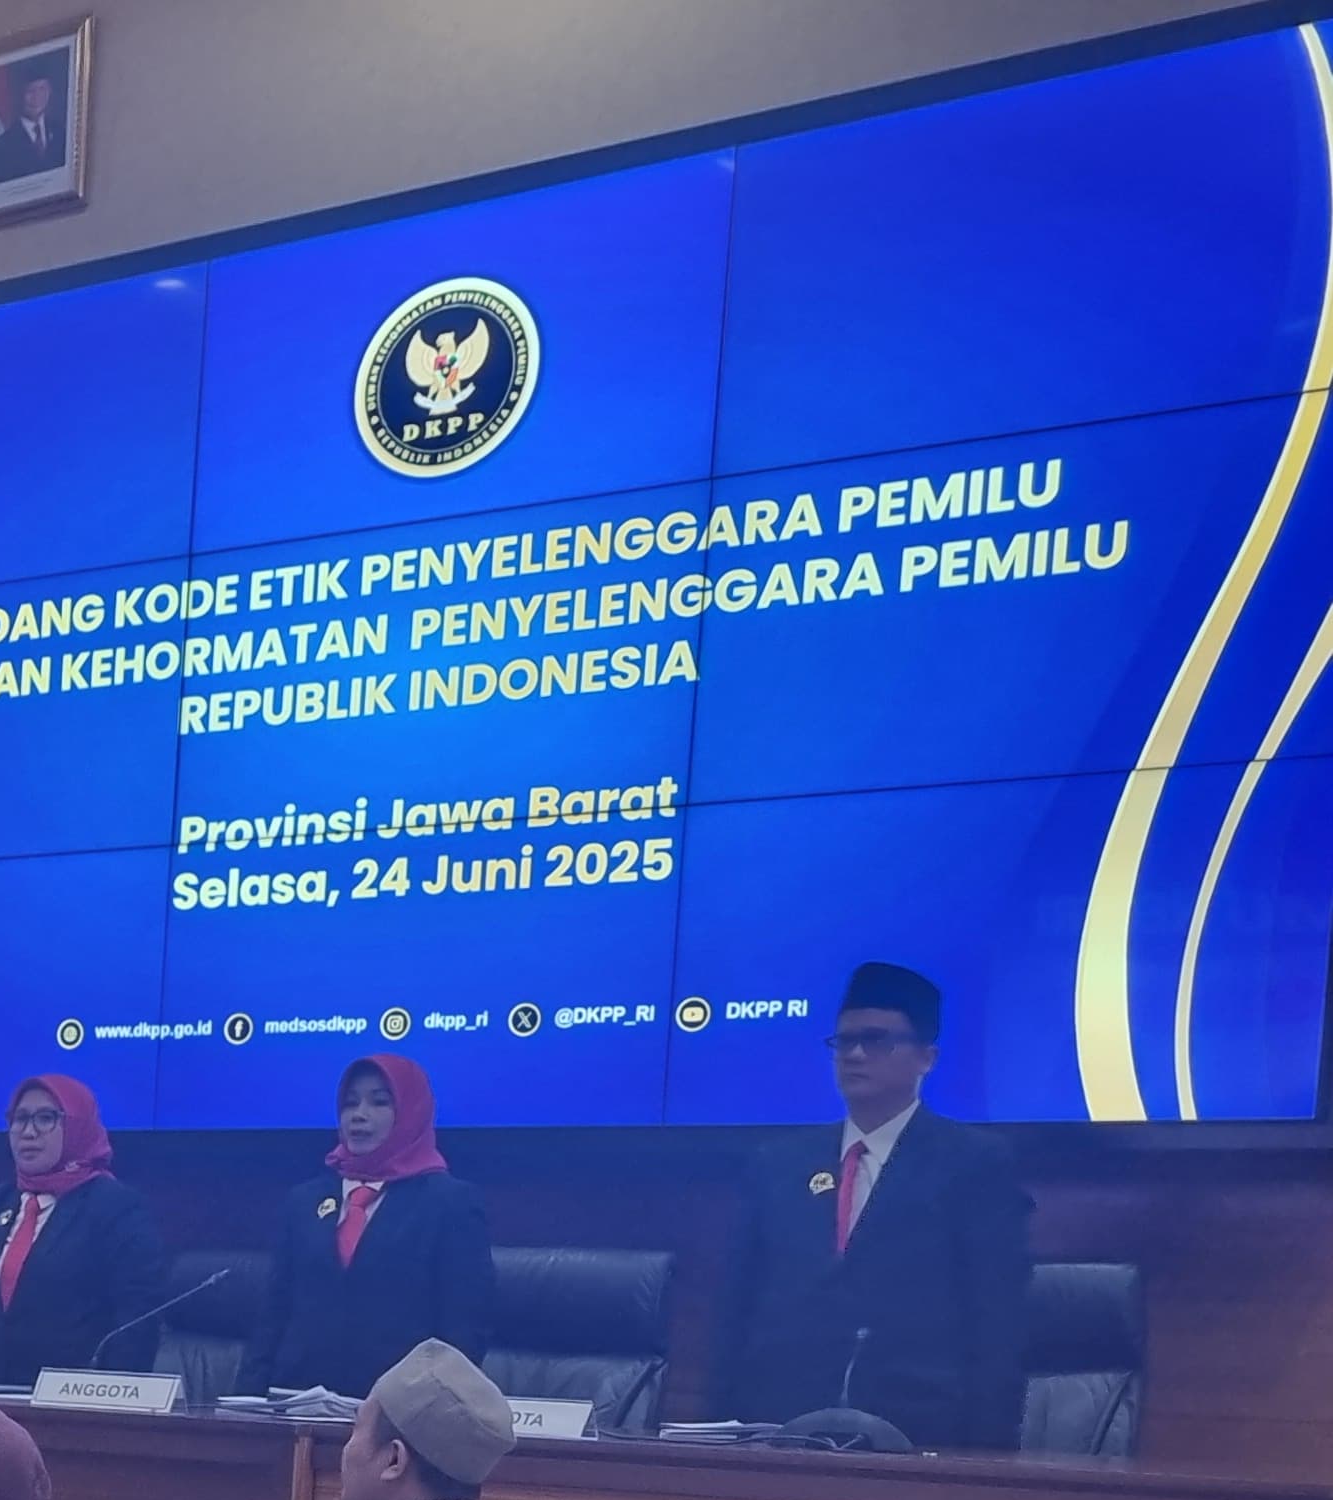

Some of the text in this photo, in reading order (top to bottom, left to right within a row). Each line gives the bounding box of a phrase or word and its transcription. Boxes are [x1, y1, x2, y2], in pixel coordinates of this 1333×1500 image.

[402, 413, 485, 442] DKPP
[114, 574, 239, 629] KODE
[249, 559, 350, 610] ETIK
[360, 493, 823, 596] PENYELENGGARA
[838, 458, 1062, 533] PEMILU
[61, 614, 388, 692] KEHORMATAN
[410, 552, 884, 650] PENYELENGGARA
[899, 520, 1128, 593] PEMILU
[179, 639, 700, 735] REPUBLIK INDONESIA
[177, 776, 678, 854] Provinsi Jawa Barat
[172, 838, 674, 910] Selasa, 24 Juni 2025
[424, 1010, 489, 1031] dkpp_ri
[554, 1005, 655, 1029] @DKPP_RI
[725, 999, 808, 1019] DKPP RI
[95, 1019, 213, 1040] www.dkpp.go.id
[264, 1016, 367, 1035] medsosdkpp
[59, 1382, 140, 1399] ANGGOTA
